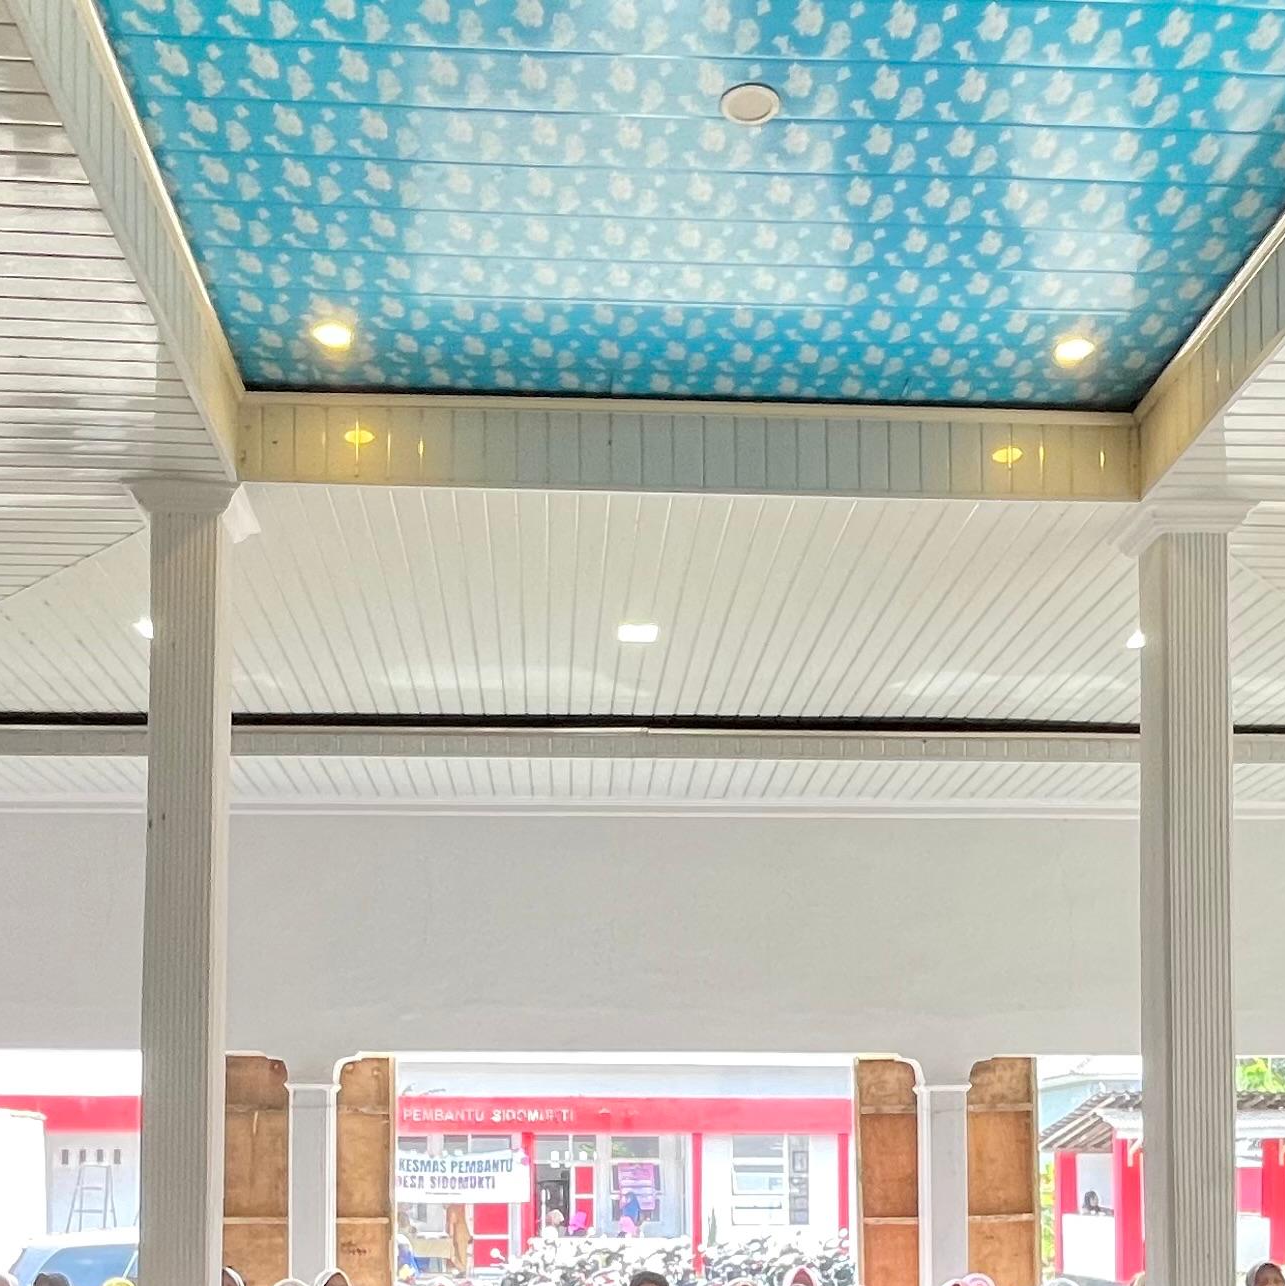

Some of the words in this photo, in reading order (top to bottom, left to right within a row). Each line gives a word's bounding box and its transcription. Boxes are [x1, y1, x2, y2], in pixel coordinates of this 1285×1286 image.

[402, 1108, 485, 1122] PEMBANTU
[398, 1158, 447, 1174] KESMAS
[450, 1158, 513, 1174] PEMBANTU
[429, 1175, 496, 1190] SIDOMUKTI
